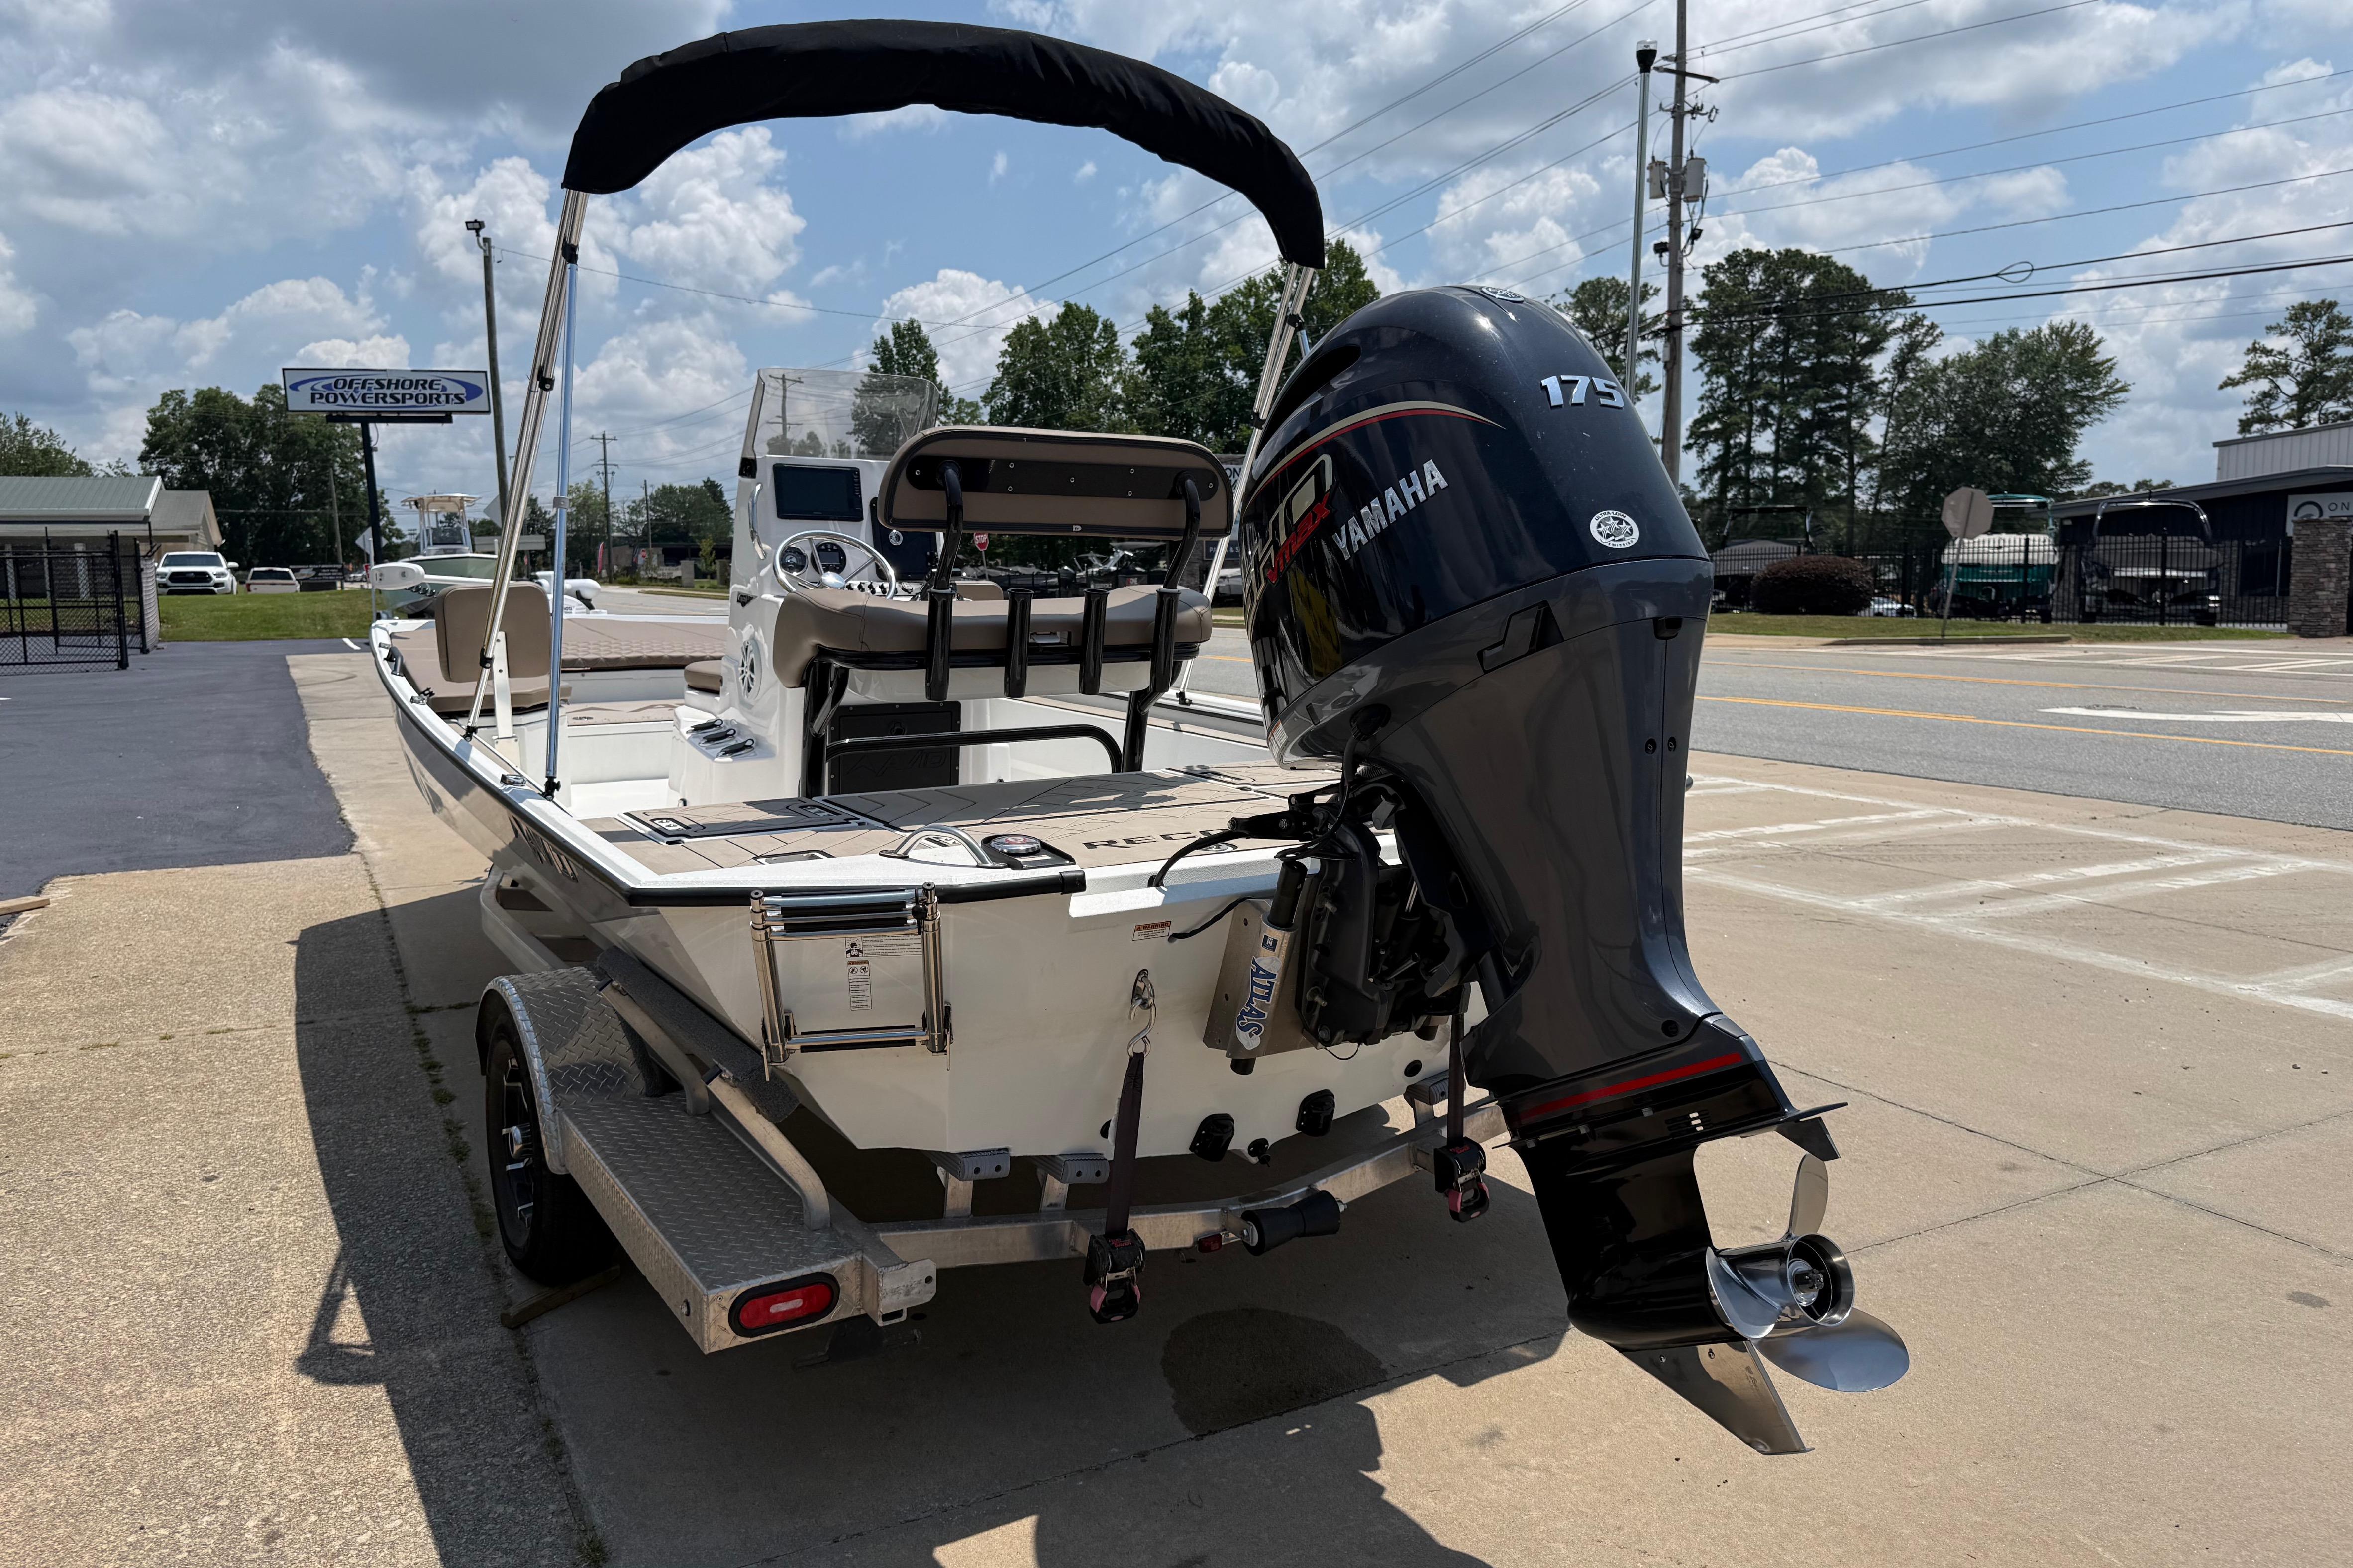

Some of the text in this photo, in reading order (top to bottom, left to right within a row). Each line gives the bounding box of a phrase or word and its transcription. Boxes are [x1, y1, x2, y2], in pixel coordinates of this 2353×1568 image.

[333, 378, 442, 391] OFFSHORE
[1540, 374, 1624, 409] 175
[310, 392, 465, 405] POWERSPORTS
[1332, 459, 1448, 561] YAMAHA
[1594, 511, 1627, 521] ULTRA-LOW
[975, 534, 987, 544] STOP
[1237, 956, 1277, 1037] ATLAS
